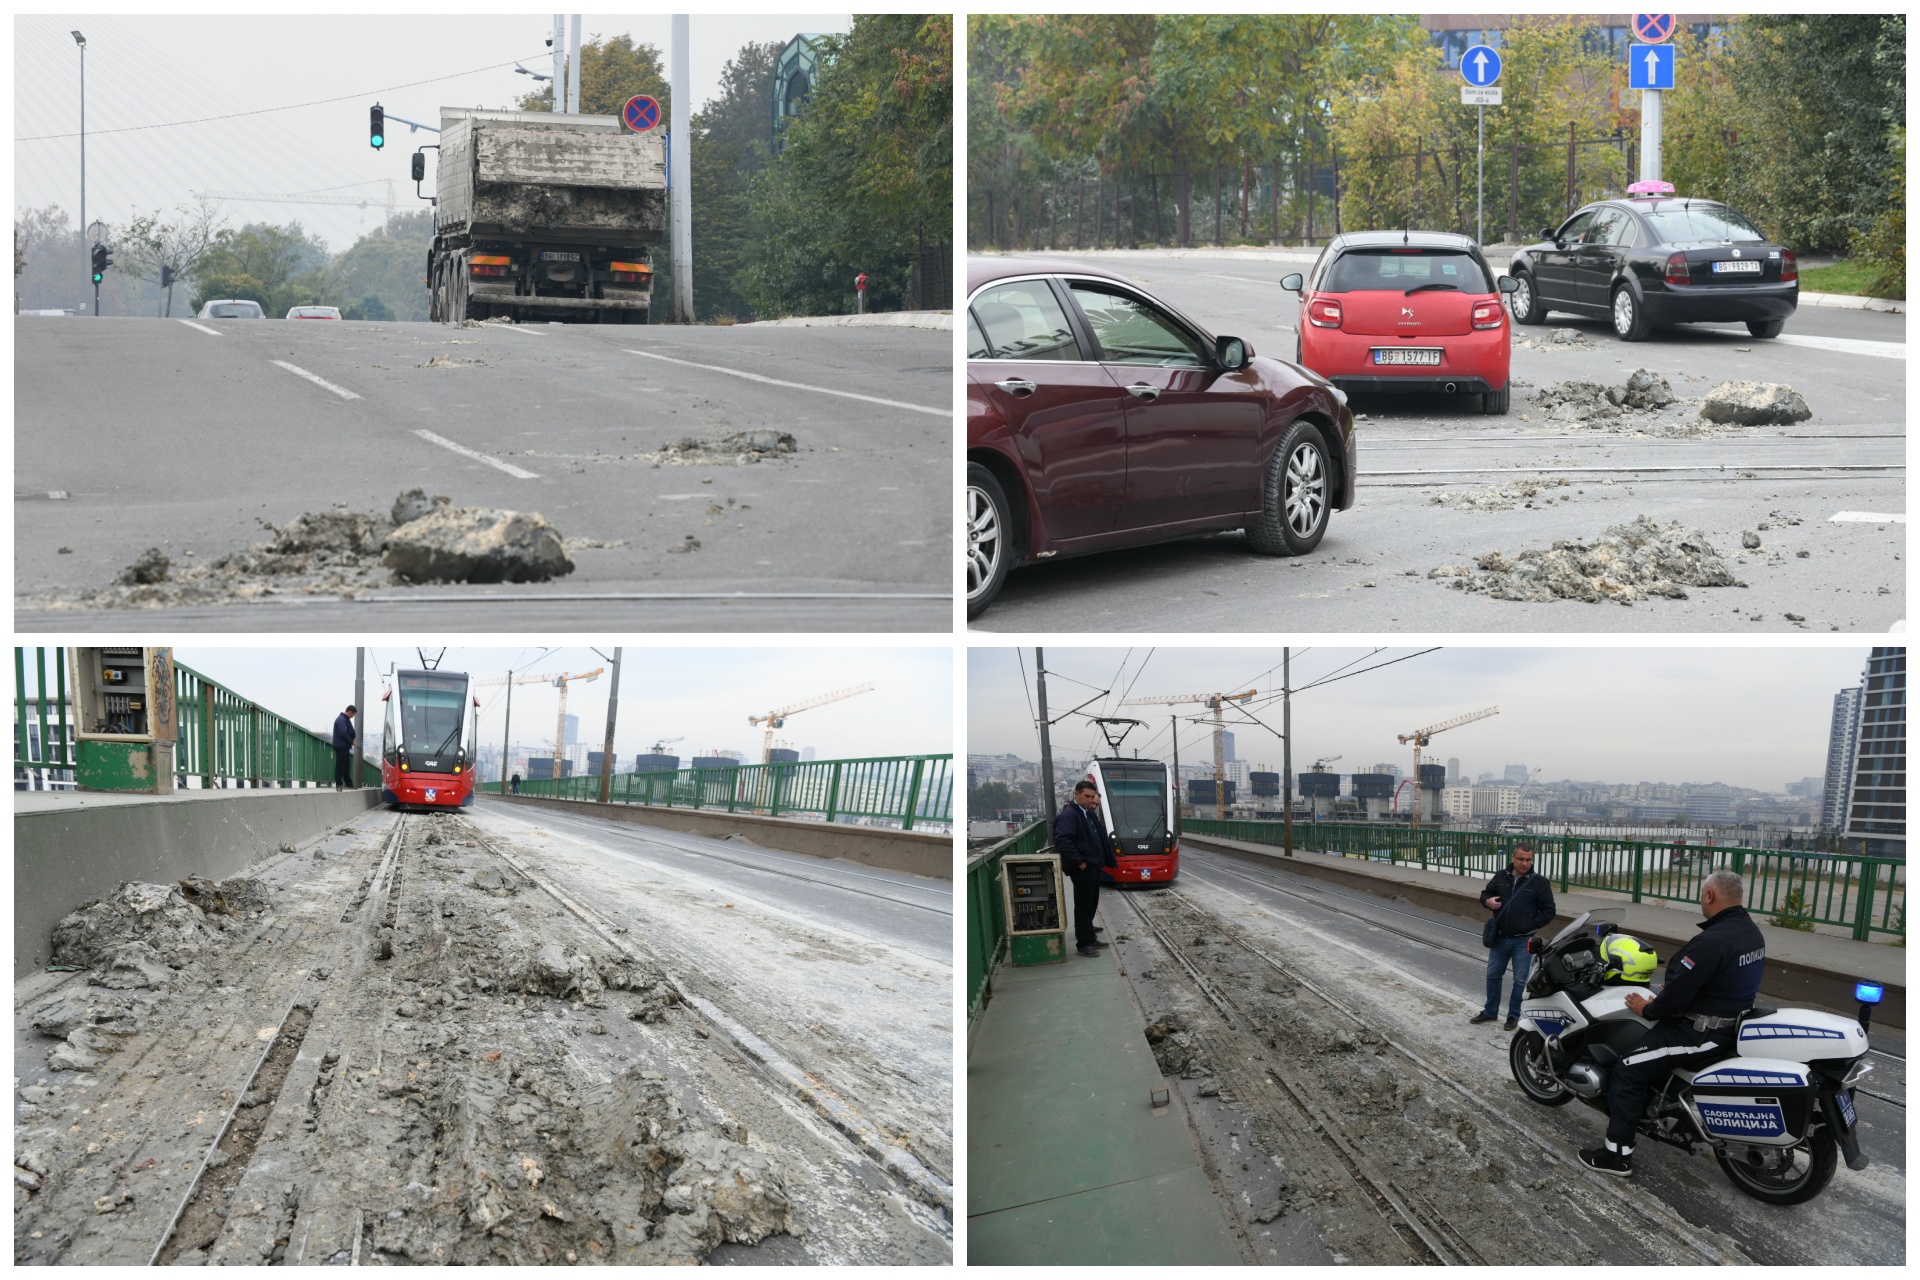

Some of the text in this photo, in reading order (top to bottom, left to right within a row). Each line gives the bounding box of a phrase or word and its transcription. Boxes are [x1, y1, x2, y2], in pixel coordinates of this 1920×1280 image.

[1718, 262, 1727, 271] BG
[1381, 350, 1394, 361] BG
[1704, 1109, 1777, 1120] САОБРАЋАЈНА
[1706, 1116, 1779, 1130] ПОЛИЦИЈА
